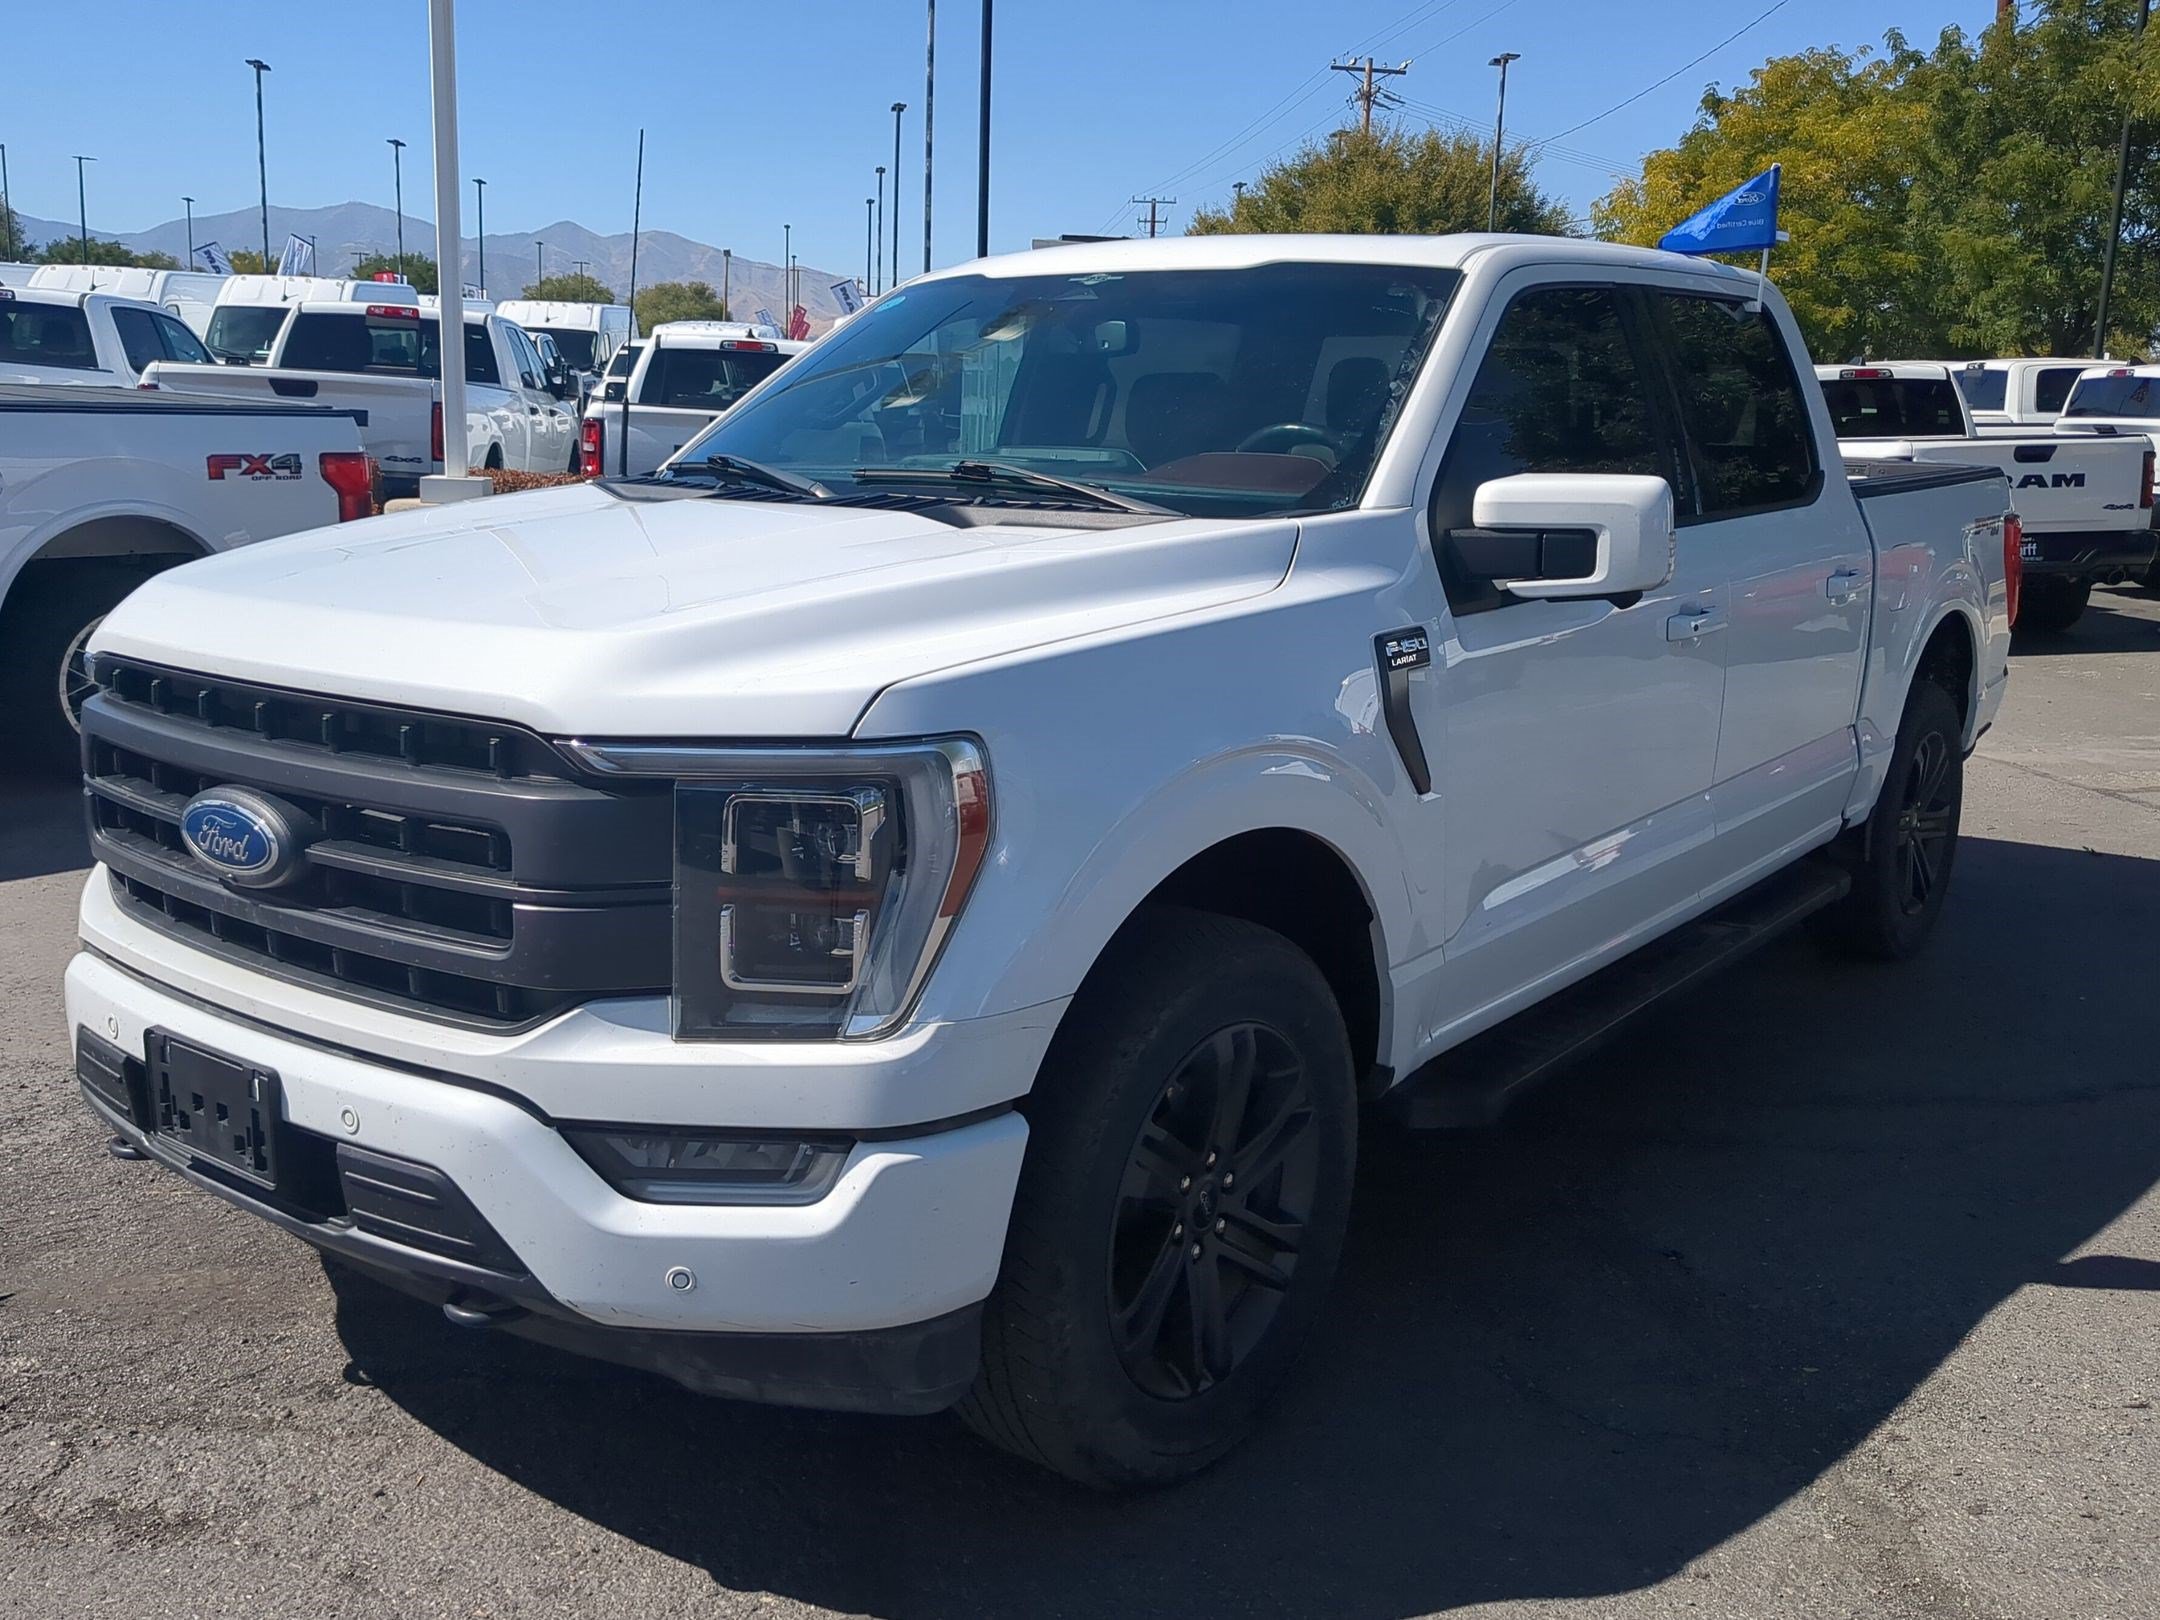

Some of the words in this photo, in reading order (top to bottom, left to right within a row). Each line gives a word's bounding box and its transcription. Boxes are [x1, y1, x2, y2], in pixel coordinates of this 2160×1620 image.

[206, 453, 303, 480] FX4
[2007, 473, 2086, 488] AM
[1385, 637, 1428, 657] F-150
[1391, 653, 1417, 667] LARIAT
[198, 814, 250, 862] Ford
